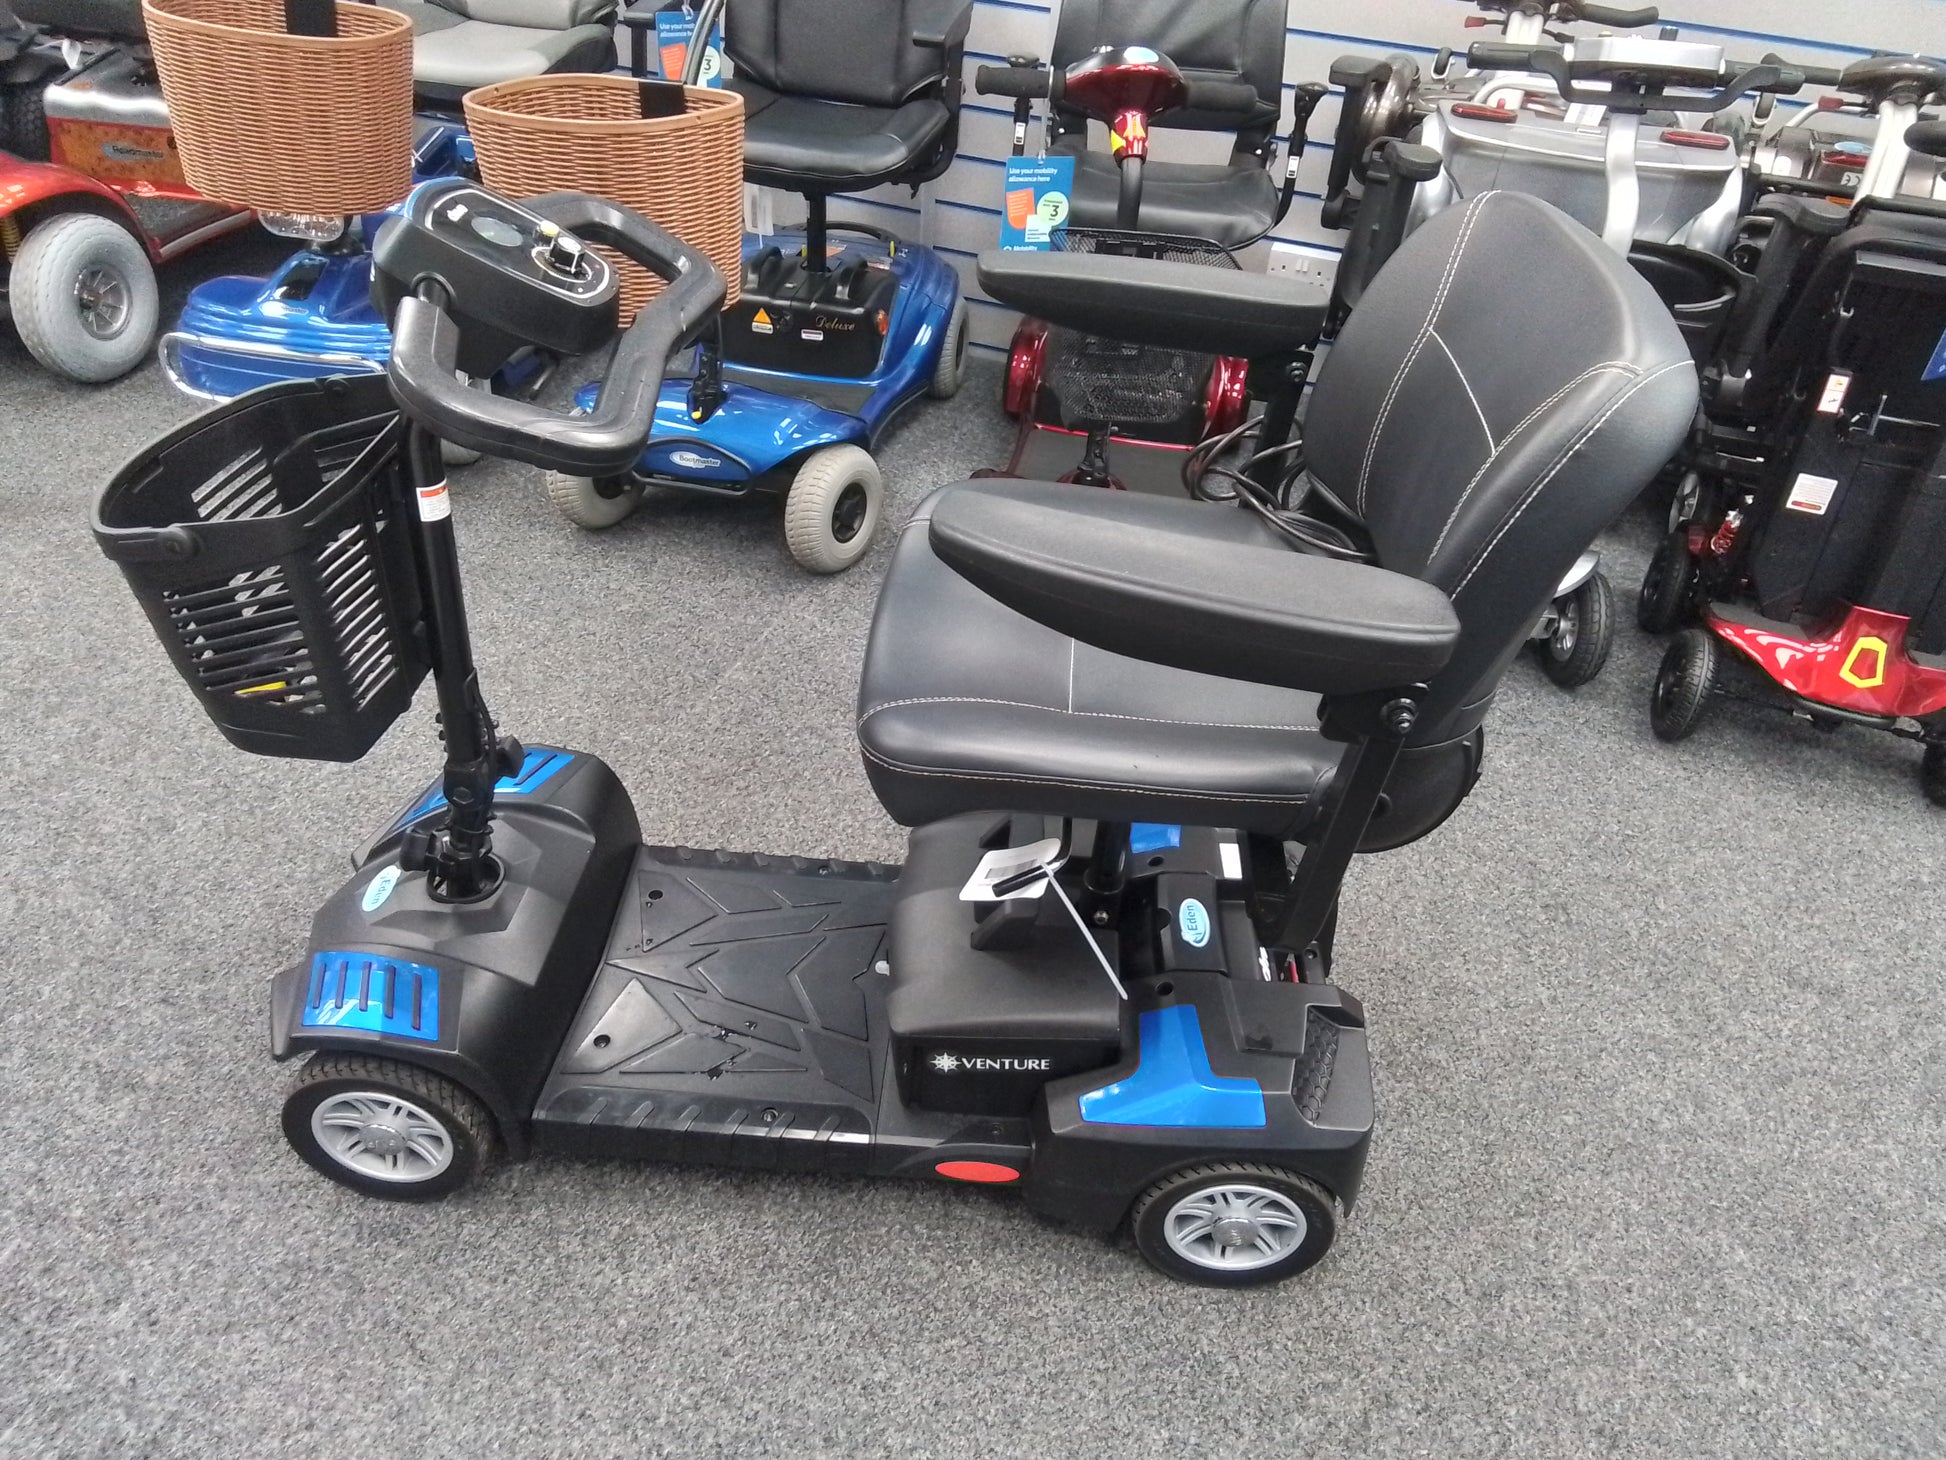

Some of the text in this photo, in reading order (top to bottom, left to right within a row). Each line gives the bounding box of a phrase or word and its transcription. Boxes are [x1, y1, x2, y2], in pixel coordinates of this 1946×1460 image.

[703, 59, 712, 71] 3
[1034, 167, 1058, 175] mobility
[1050, 204, 1060, 217] 3
[815, 315, 856, 331] Deluxe
[679, 454, 720, 466] Bootmaster
[1186, 904, 1198, 931] Eden
[961, 1057, 1050, 1071] VENTURE
